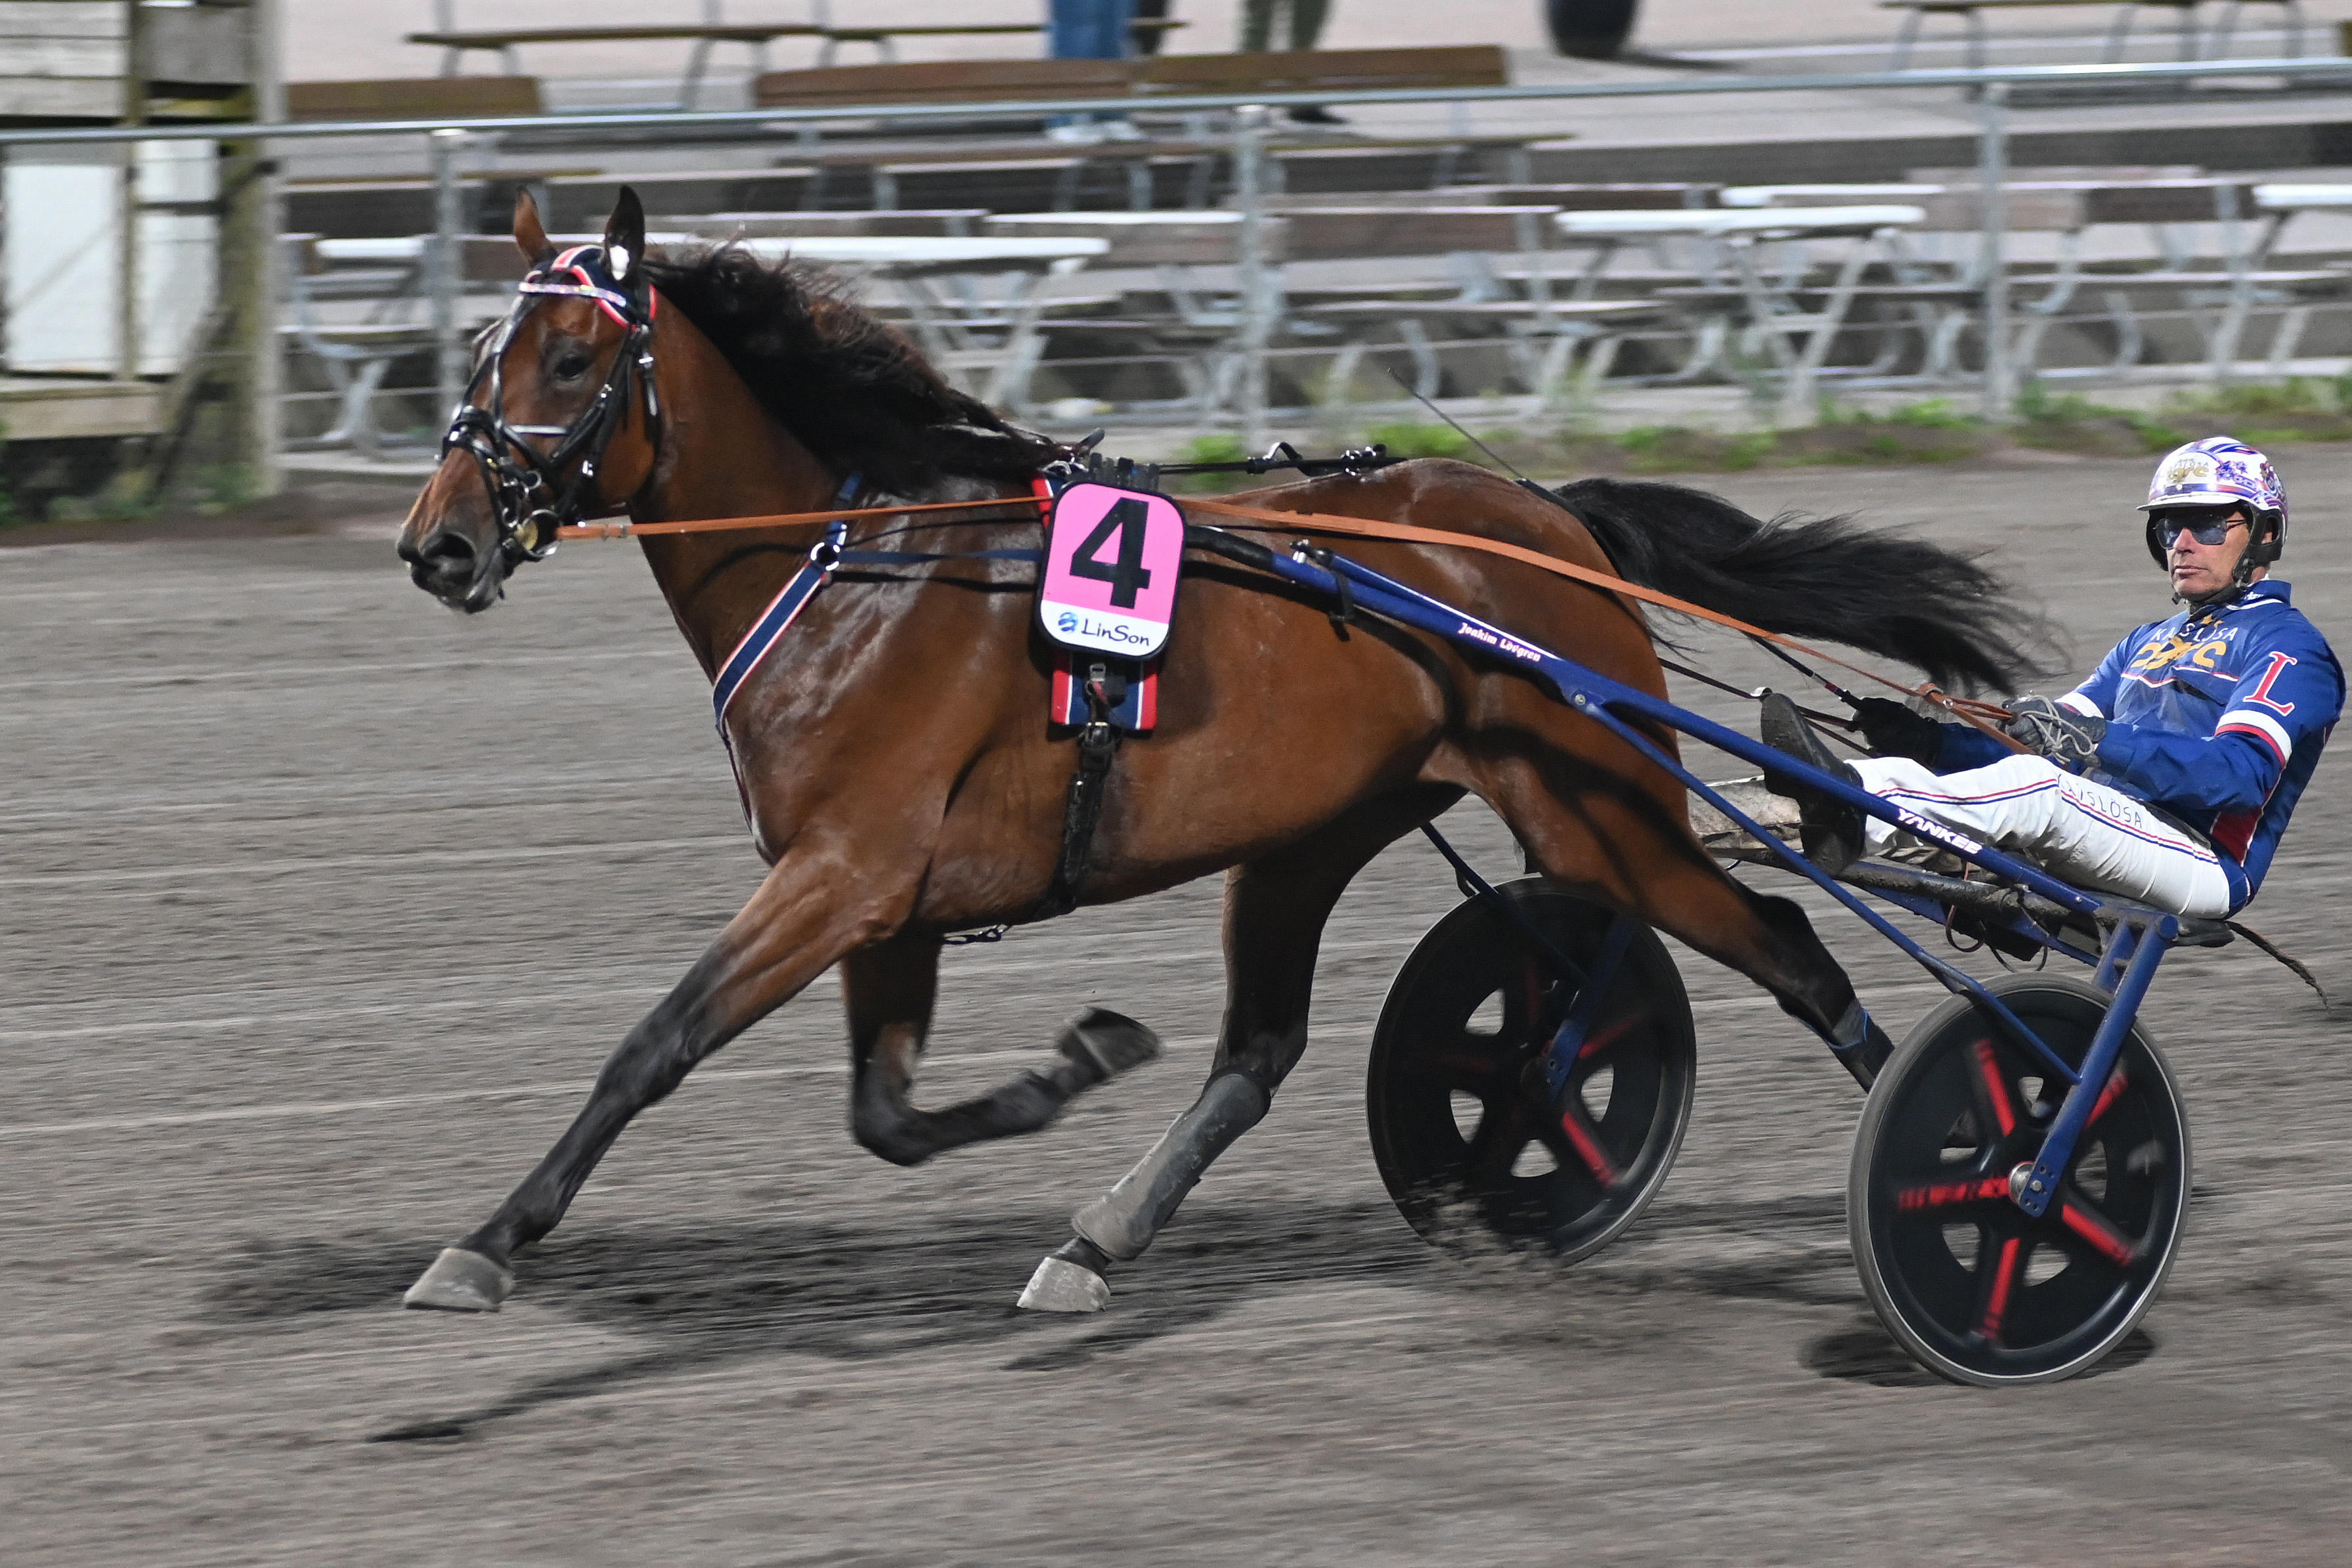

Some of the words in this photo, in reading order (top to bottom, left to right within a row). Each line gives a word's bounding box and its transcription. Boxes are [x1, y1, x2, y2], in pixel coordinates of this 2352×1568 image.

[1069, 496, 1151, 609] 4
[1081, 618, 1150, 647] LinSon
[1458, 622, 1498, 645] Joakim
[1500, 638, 1542, 663] Lövgren
[2242, 650, 2298, 717] L
[1896, 808, 1983, 855] YANKEE
